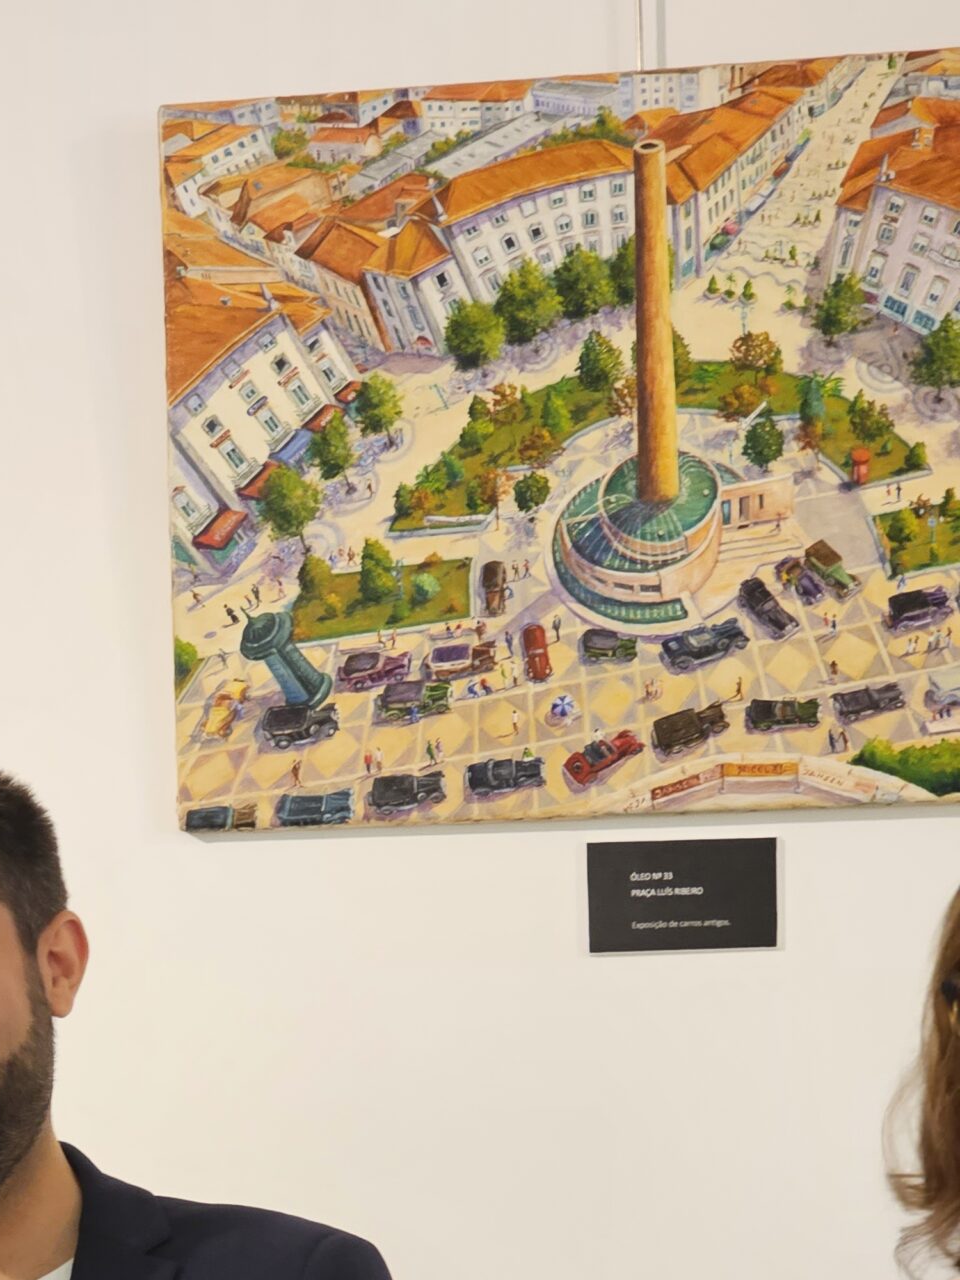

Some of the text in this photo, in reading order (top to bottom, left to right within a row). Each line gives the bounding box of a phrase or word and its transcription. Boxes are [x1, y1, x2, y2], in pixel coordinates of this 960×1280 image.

[630, 872, 651, 881] ÓLEO
[631, 886, 704, 898] PRAÇA LUÍS RIBEIRO
[669, 920, 678, 928] de
